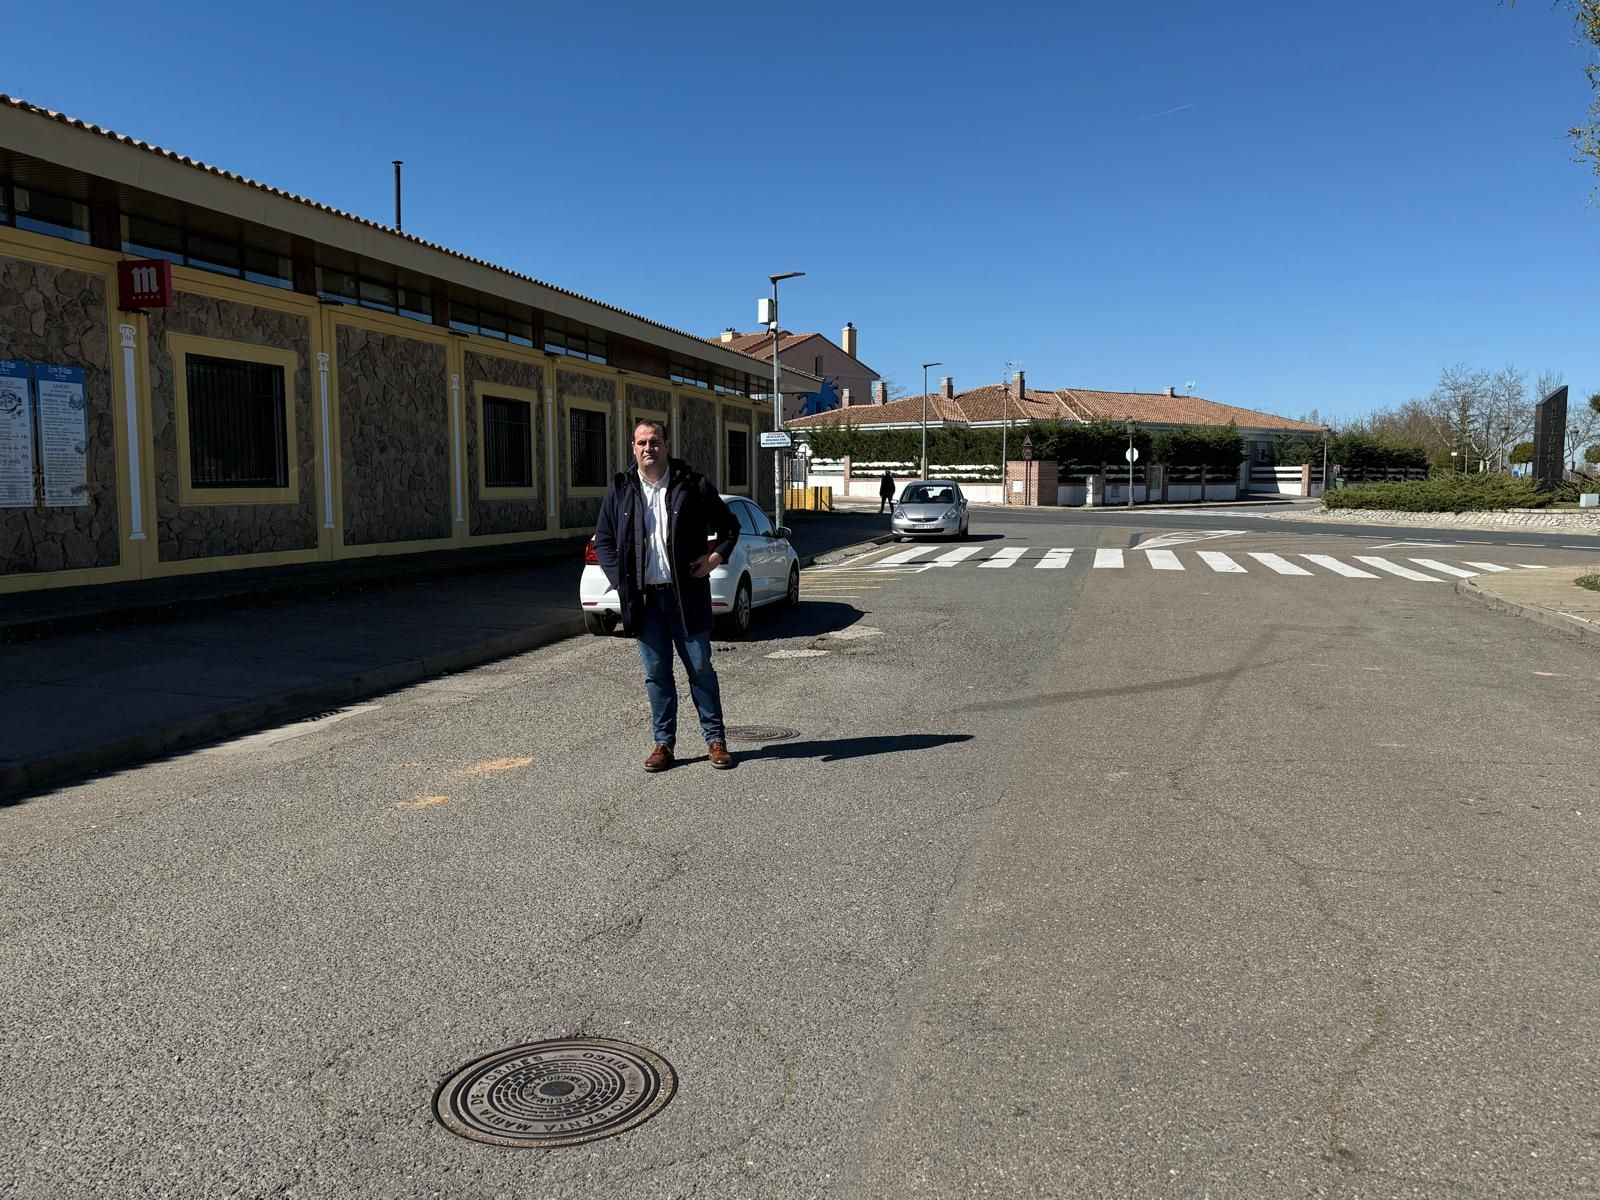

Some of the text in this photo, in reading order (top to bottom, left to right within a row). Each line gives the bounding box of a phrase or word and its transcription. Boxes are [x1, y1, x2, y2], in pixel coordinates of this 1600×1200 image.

[477, 1055, 544, 1087] TORMES
[581, 1052, 629, 1071] RIEGO
[470, 1093, 485, 1107] DE
[480, 1108, 533, 1132] MARTA
[543, 1112, 608, 1132] SANTA
